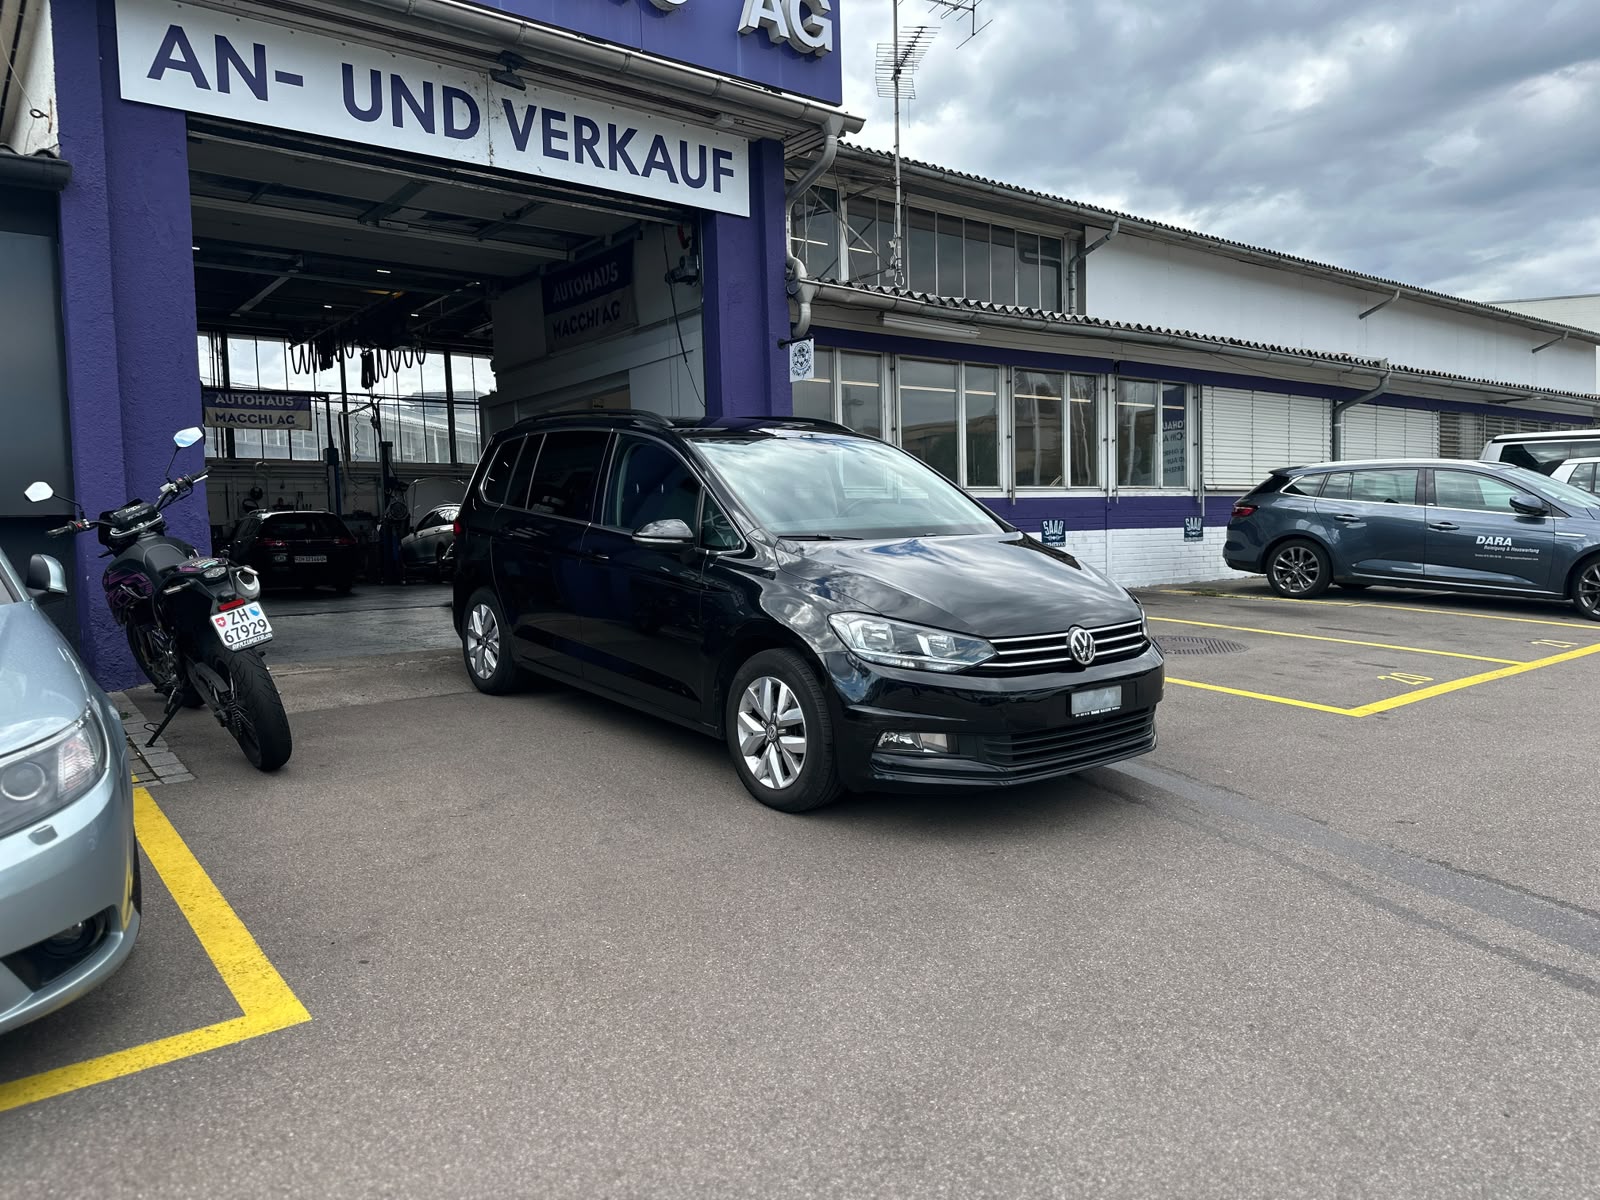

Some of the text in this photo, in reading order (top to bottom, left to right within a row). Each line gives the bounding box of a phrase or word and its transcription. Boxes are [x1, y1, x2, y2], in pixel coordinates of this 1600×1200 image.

[738, 0, 832, 56] AG
[146, 24, 734, 194] AN- UND VERKAUF
[552, 261, 619, 304] AUTOHAUS
[552, 300, 621, 340] MACCHI AG
[215, 393, 294, 407] AUTOHAUS
[214, 411, 295, 425] MACCHI AG
[1042, 520, 1064, 535] SAAB
[1475, 535, 1513, 547] DARA
[226, 608, 250, 625] ZH
[224, 618, 267, 644] 67929
